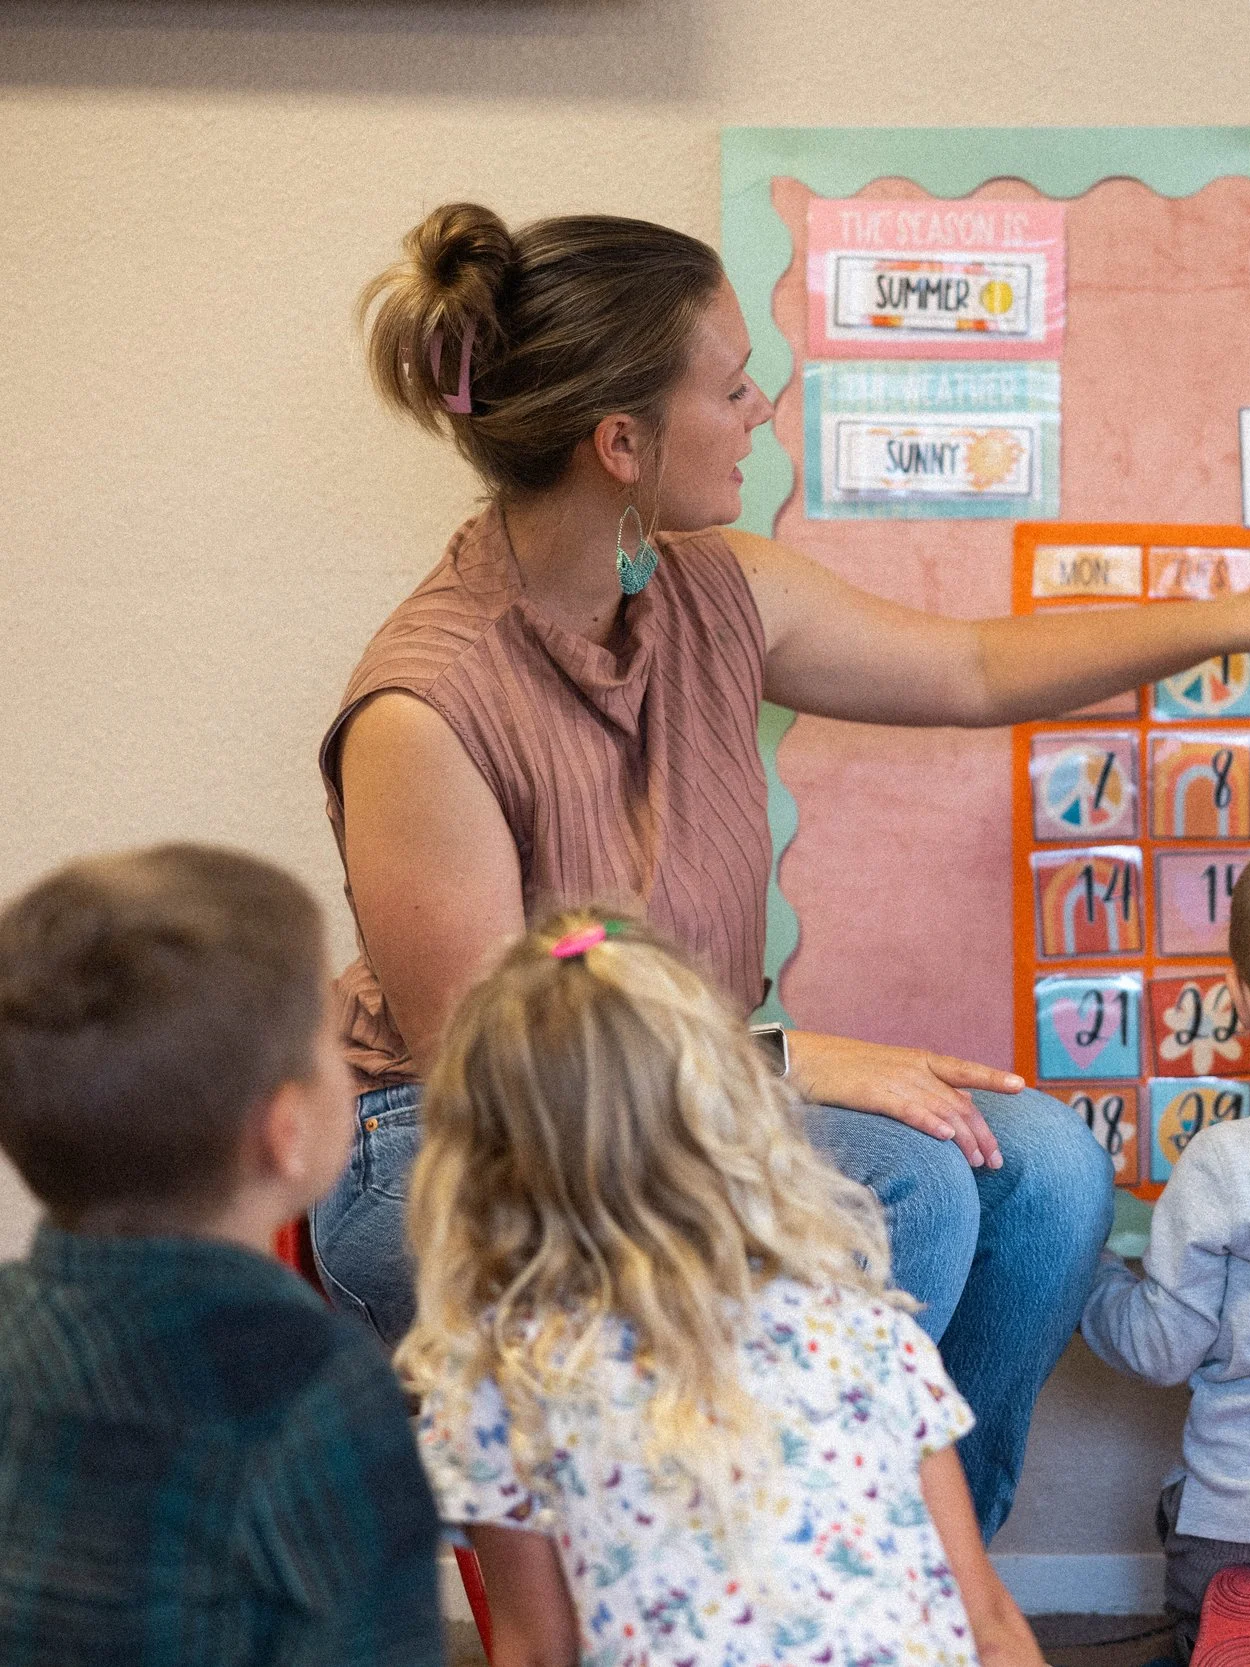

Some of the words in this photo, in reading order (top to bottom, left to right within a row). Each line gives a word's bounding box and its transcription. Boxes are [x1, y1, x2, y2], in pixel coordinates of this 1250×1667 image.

[840, 210, 892, 245] THE
[896, 210, 996, 245] SEASON
[1003, 211, 1029, 245] IS
[875, 274, 971, 311] SUMMER
[885, 439, 960, 476] SUNNY
[1058, 558, 1111, 587] MON
[1212, 750, 1234, 809] 8
[1078, 860, 1132, 924] 14
[1075, 989, 1130, 1048] 21
